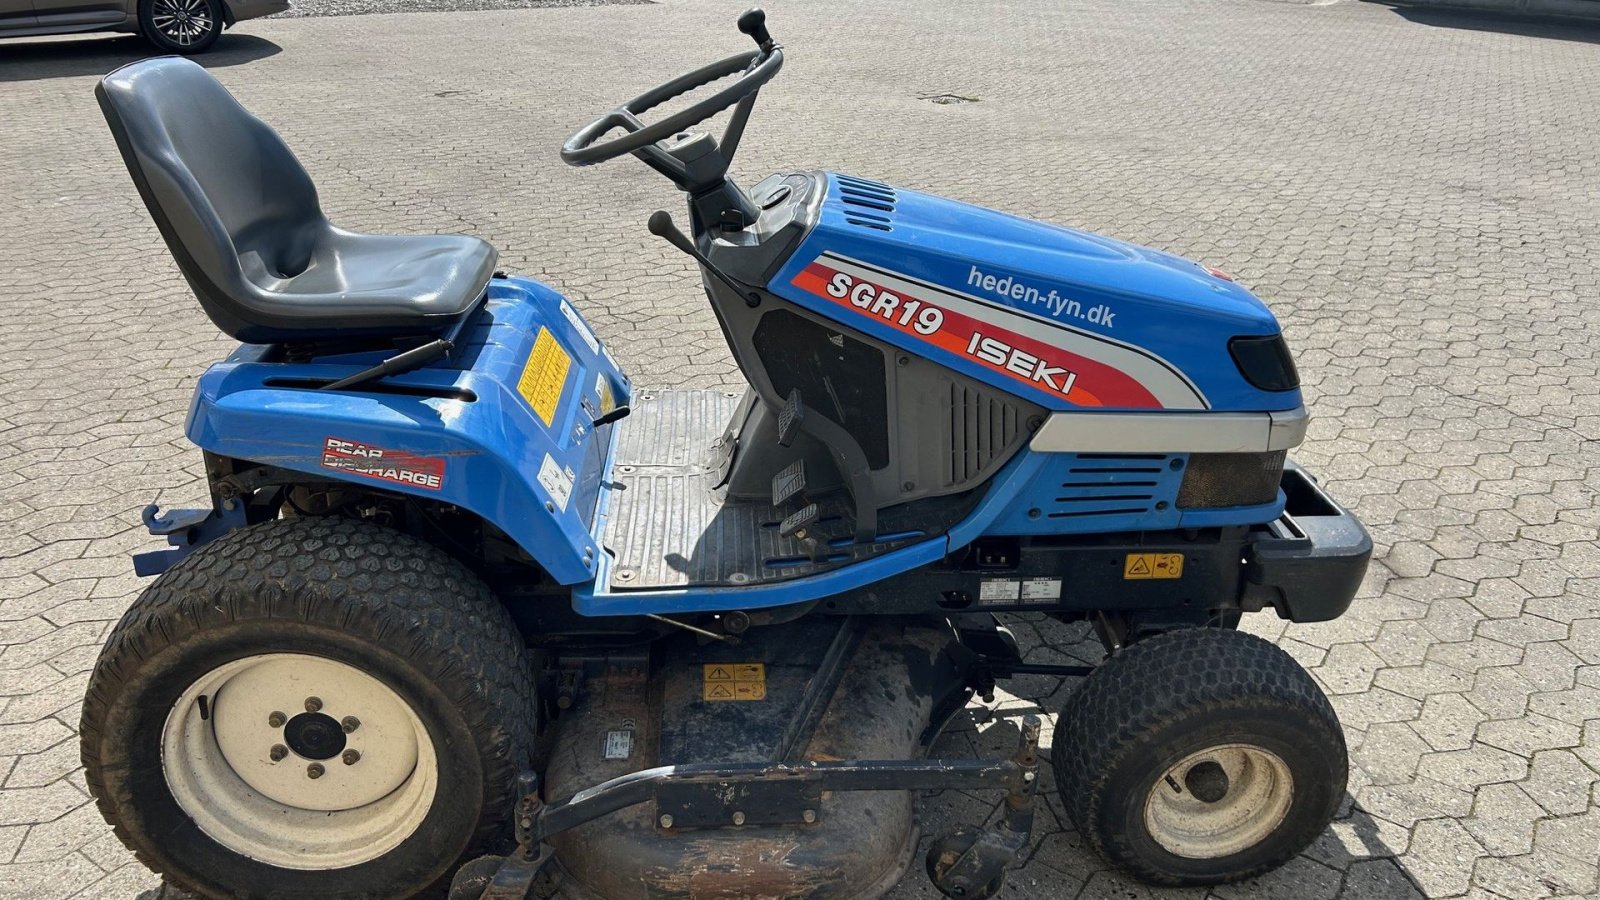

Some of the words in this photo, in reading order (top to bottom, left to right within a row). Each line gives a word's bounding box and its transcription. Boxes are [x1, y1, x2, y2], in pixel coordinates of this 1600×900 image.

[826, 273, 944, 335] SGR19
[967, 266, 1115, 328] heden-fyn.dk
[966, 332, 1077, 394] ISEKI
